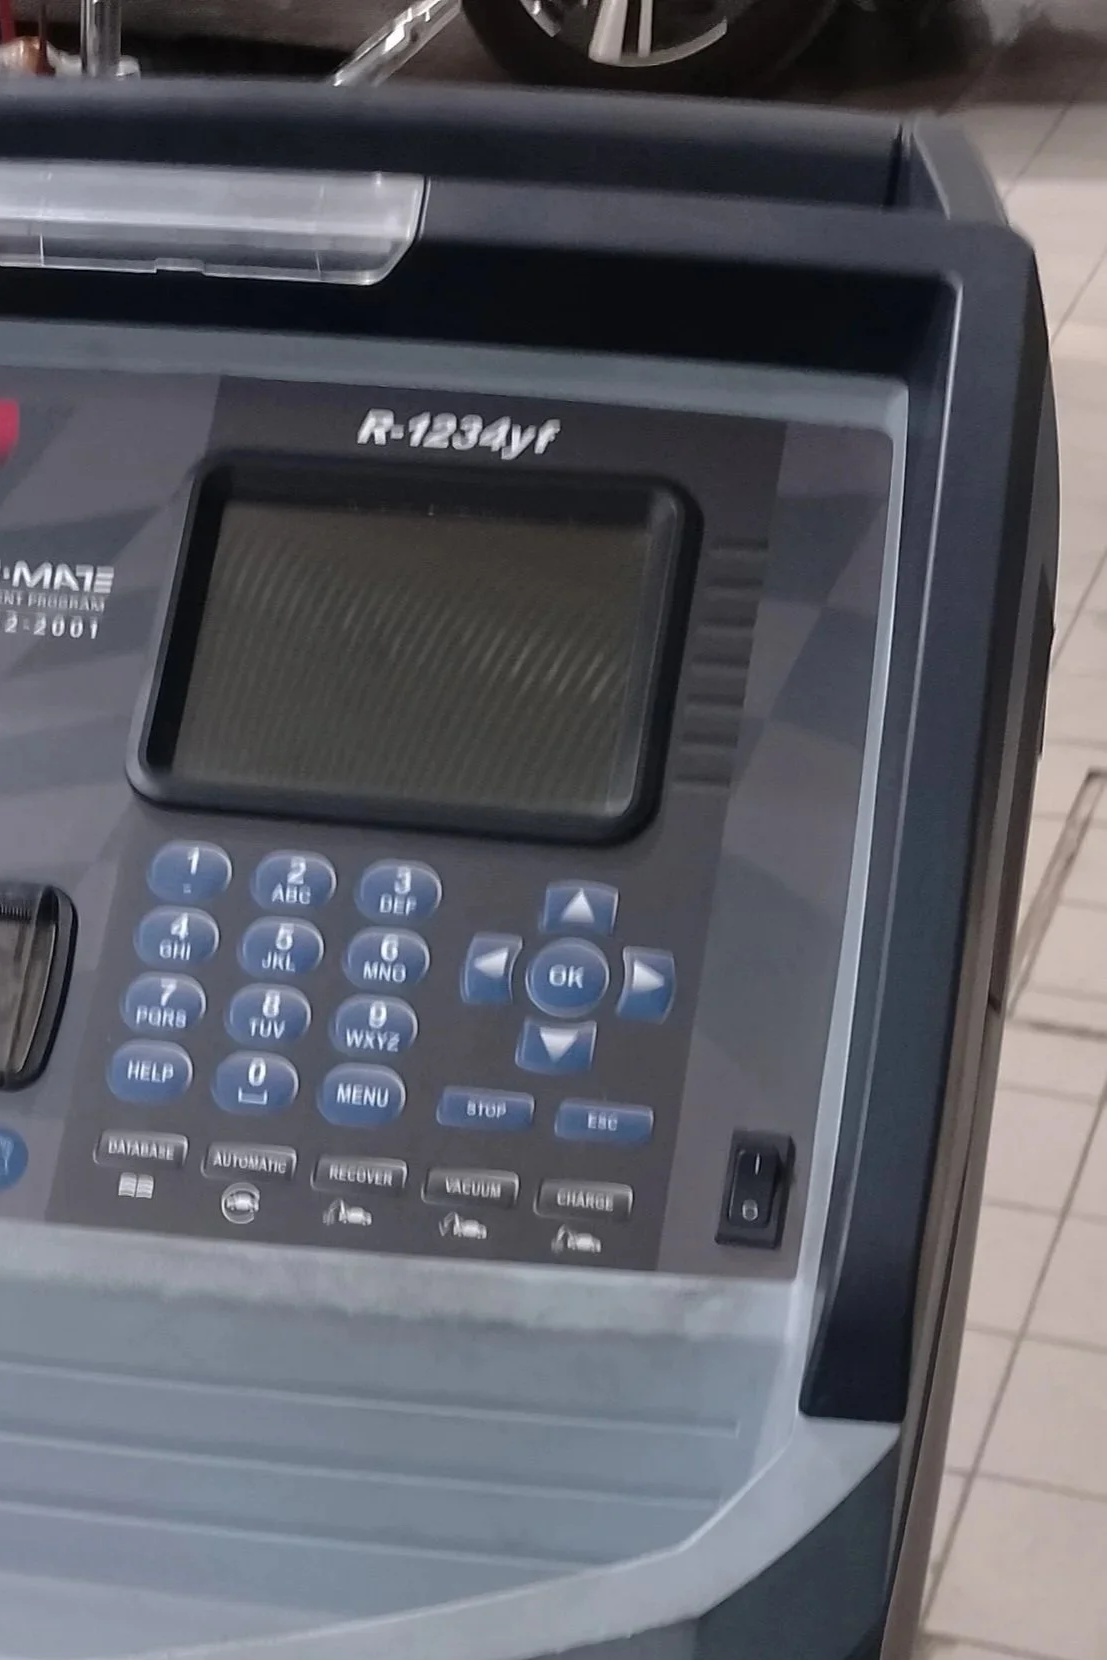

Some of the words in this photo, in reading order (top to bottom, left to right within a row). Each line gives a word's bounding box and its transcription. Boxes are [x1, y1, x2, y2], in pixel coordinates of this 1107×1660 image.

[357, 408, 561, 460] R-1234yf
[28, 593, 105, 614] PROGRAM
[187, 847, 200, 874] 1
[287, 857, 306, 884] 2
[394, 866, 412, 893] 3
[271, 884, 311, 905] ABC
[379, 894, 417, 915] DEF
[170, 913, 189, 939] 4
[275, 923, 294, 950] 5
[159, 939, 192, 960] GHI
[380, 934, 399, 961] 6
[262, 952, 296, 973] JKL
[363, 961, 407, 983] MNO
[549, 963, 584, 989] OK
[161, 979, 179, 1006] 7
[262, 989, 281, 1018] 8
[135, 1006, 187, 1029] PQRS
[369, 1001, 387, 1028] 9
[249, 1018, 286, 1039] TUV
[345, 1029, 401, 1052] WXYZ
[127, 1060, 175, 1084] HELP
[248, 1057, 267, 1086] 0
[336, 1083, 389, 1108] MENU
[466, 1102, 507, 1119] STOP
[587, 1112, 618, 1131] ESC
[108, 1136, 175, 1161] DATABASE
[213, 1151, 287, 1174] AUTOMATIC
[329, 1163, 393, 1186] RECOVER
[445, 1175, 501, 1198] VACUUM
[556, 1189, 614, 1212] CHARGE
